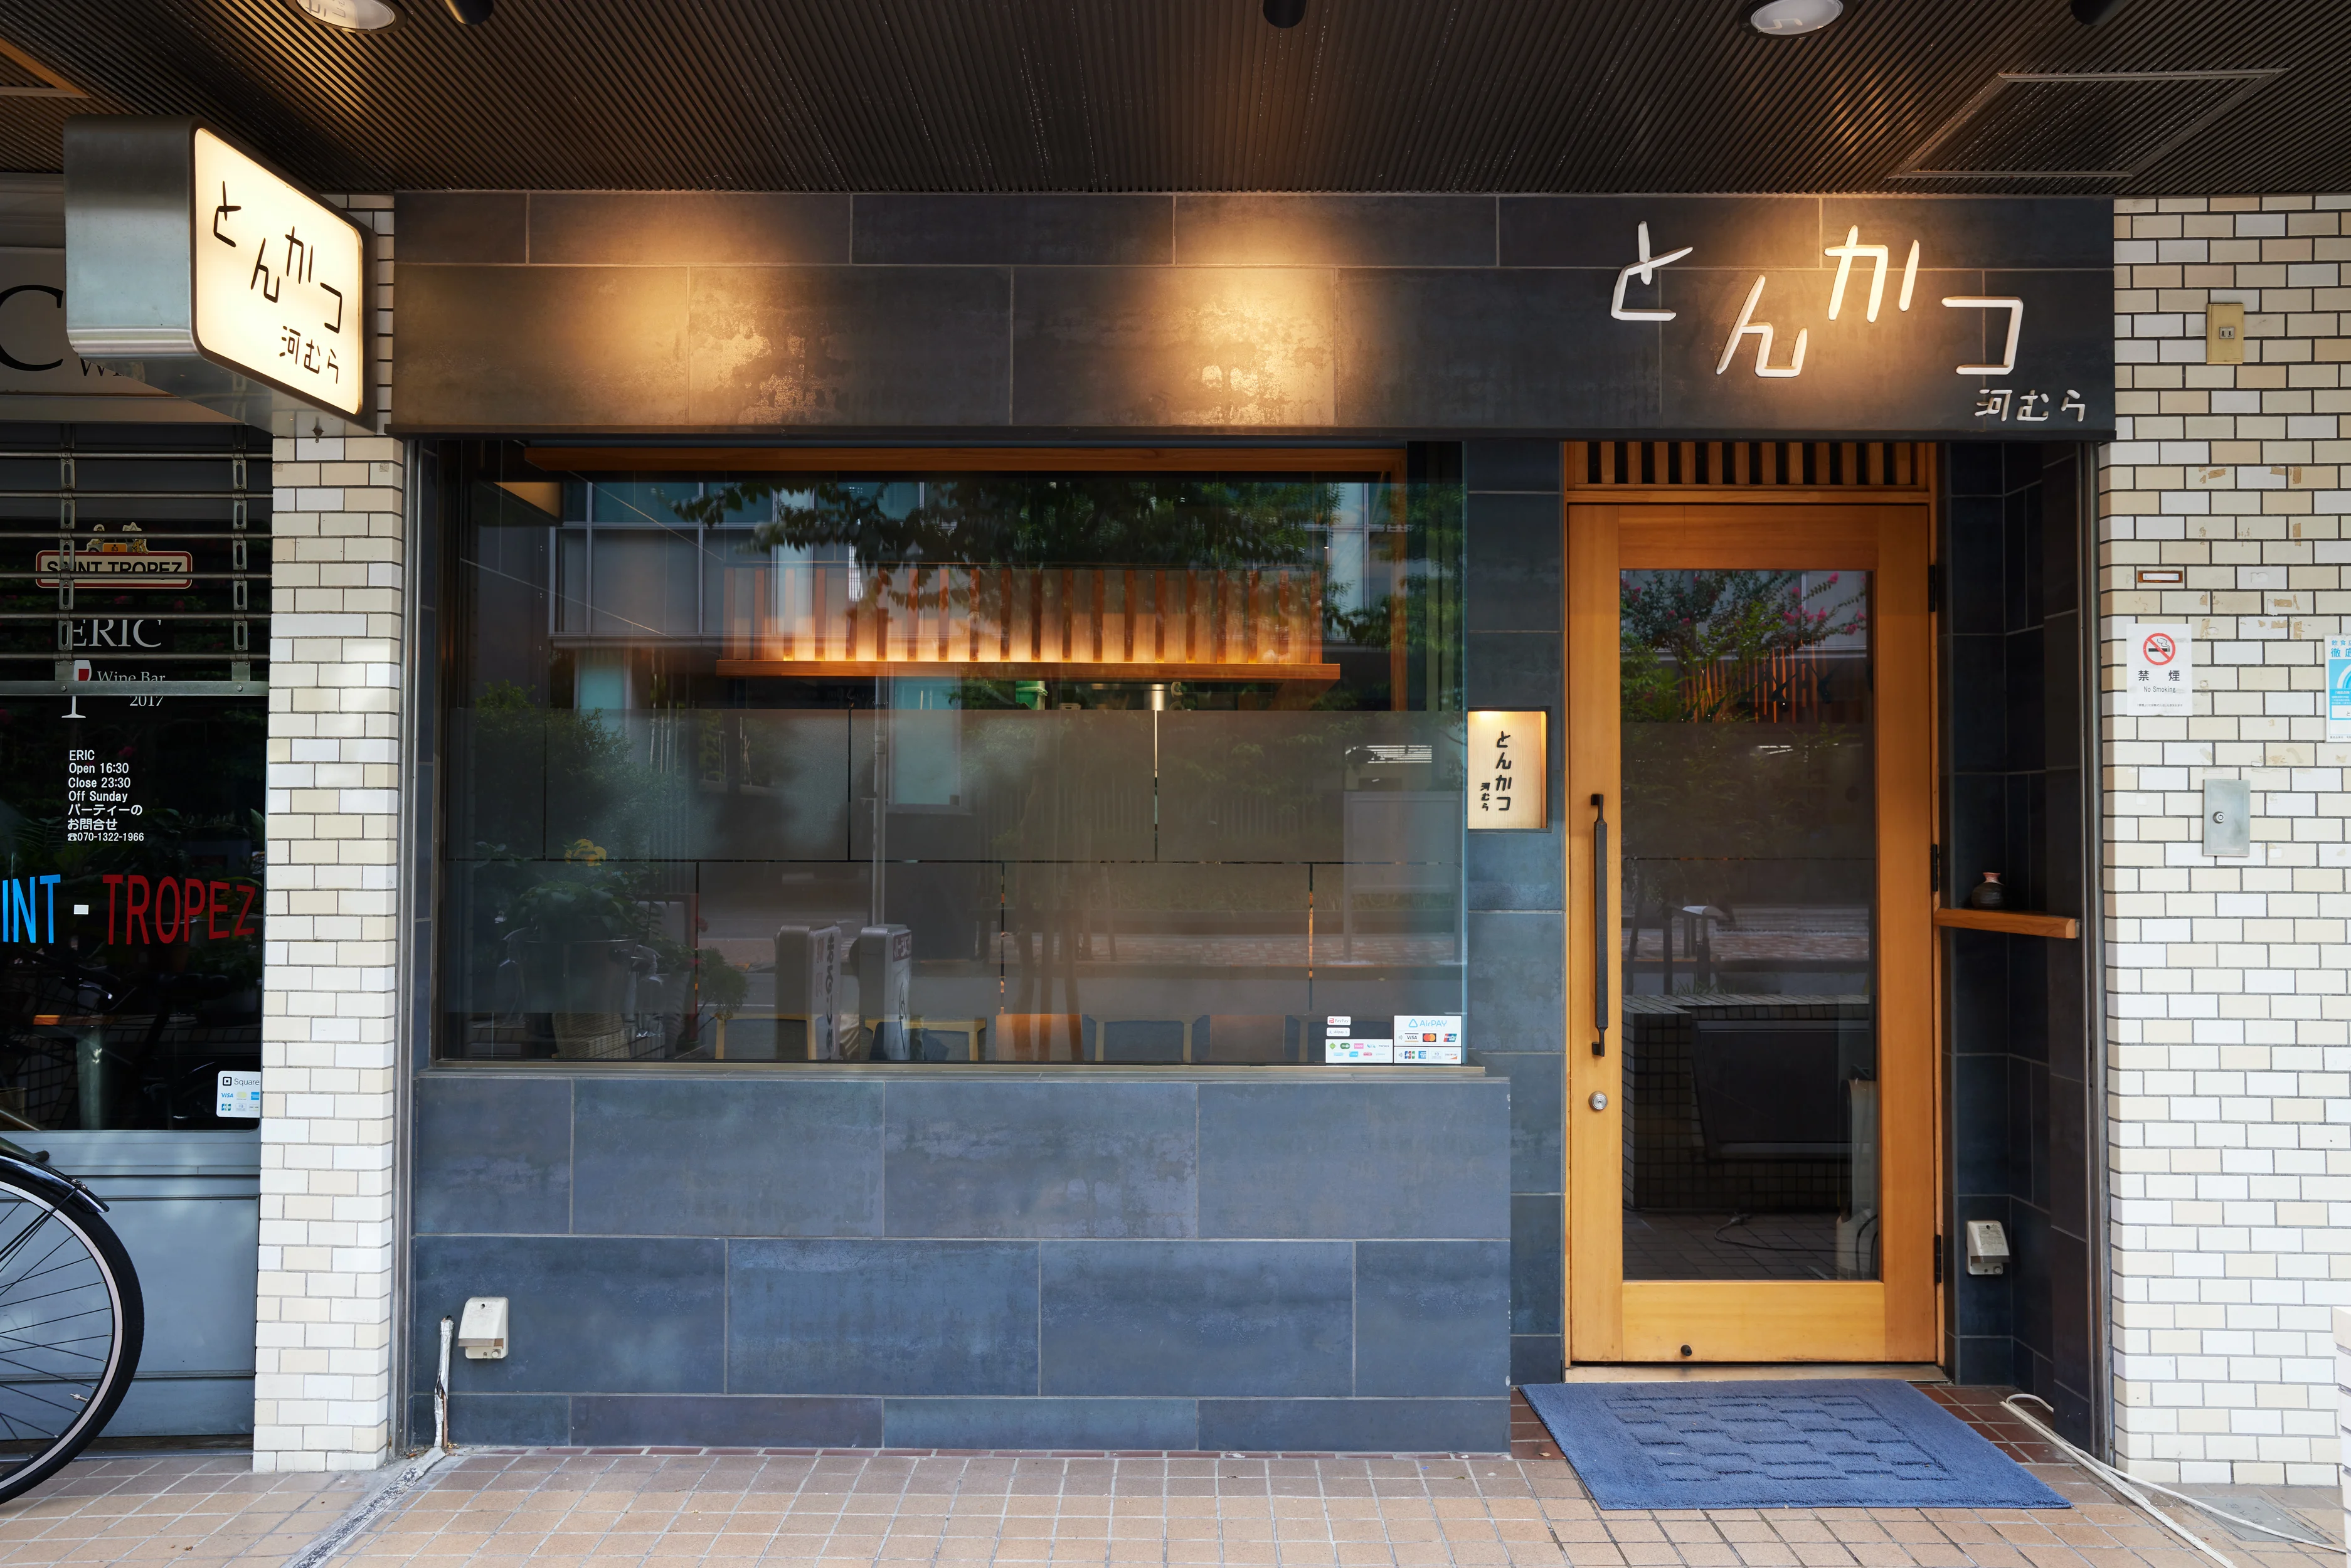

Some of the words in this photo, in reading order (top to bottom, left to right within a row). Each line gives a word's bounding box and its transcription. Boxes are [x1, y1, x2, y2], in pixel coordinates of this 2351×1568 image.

[213, 180, 343, 334] とんかつ
[1610, 220, 2023, 378] とんかつ
[279, 326, 339, 384] 河むら
[1974, 389, 2086, 422] 河むら
[97, 671, 136, 681] Wine
[141, 671, 166, 681] Bar
[129, 696, 164, 706] 2017
[69, 750, 95, 761] ERIC
[69, 763, 95, 775] Open
[100, 763, 129, 773] 16:30
[1495, 731, 1512, 811] とんかつ
[68, 777, 97, 788] Close
[101, 777, 130, 788] 23:30
[68, 790, 85, 802] Off
[90, 790, 128, 803] Sunday
[68, 803, 143, 816] パーティーの
[67, 818, 118, 830] お問合せ
[77, 832, 144, 842] 070-1322-1966
[102, 874, 257, 945] TROPEZ
[234, 1078, 260, 1086] Square
